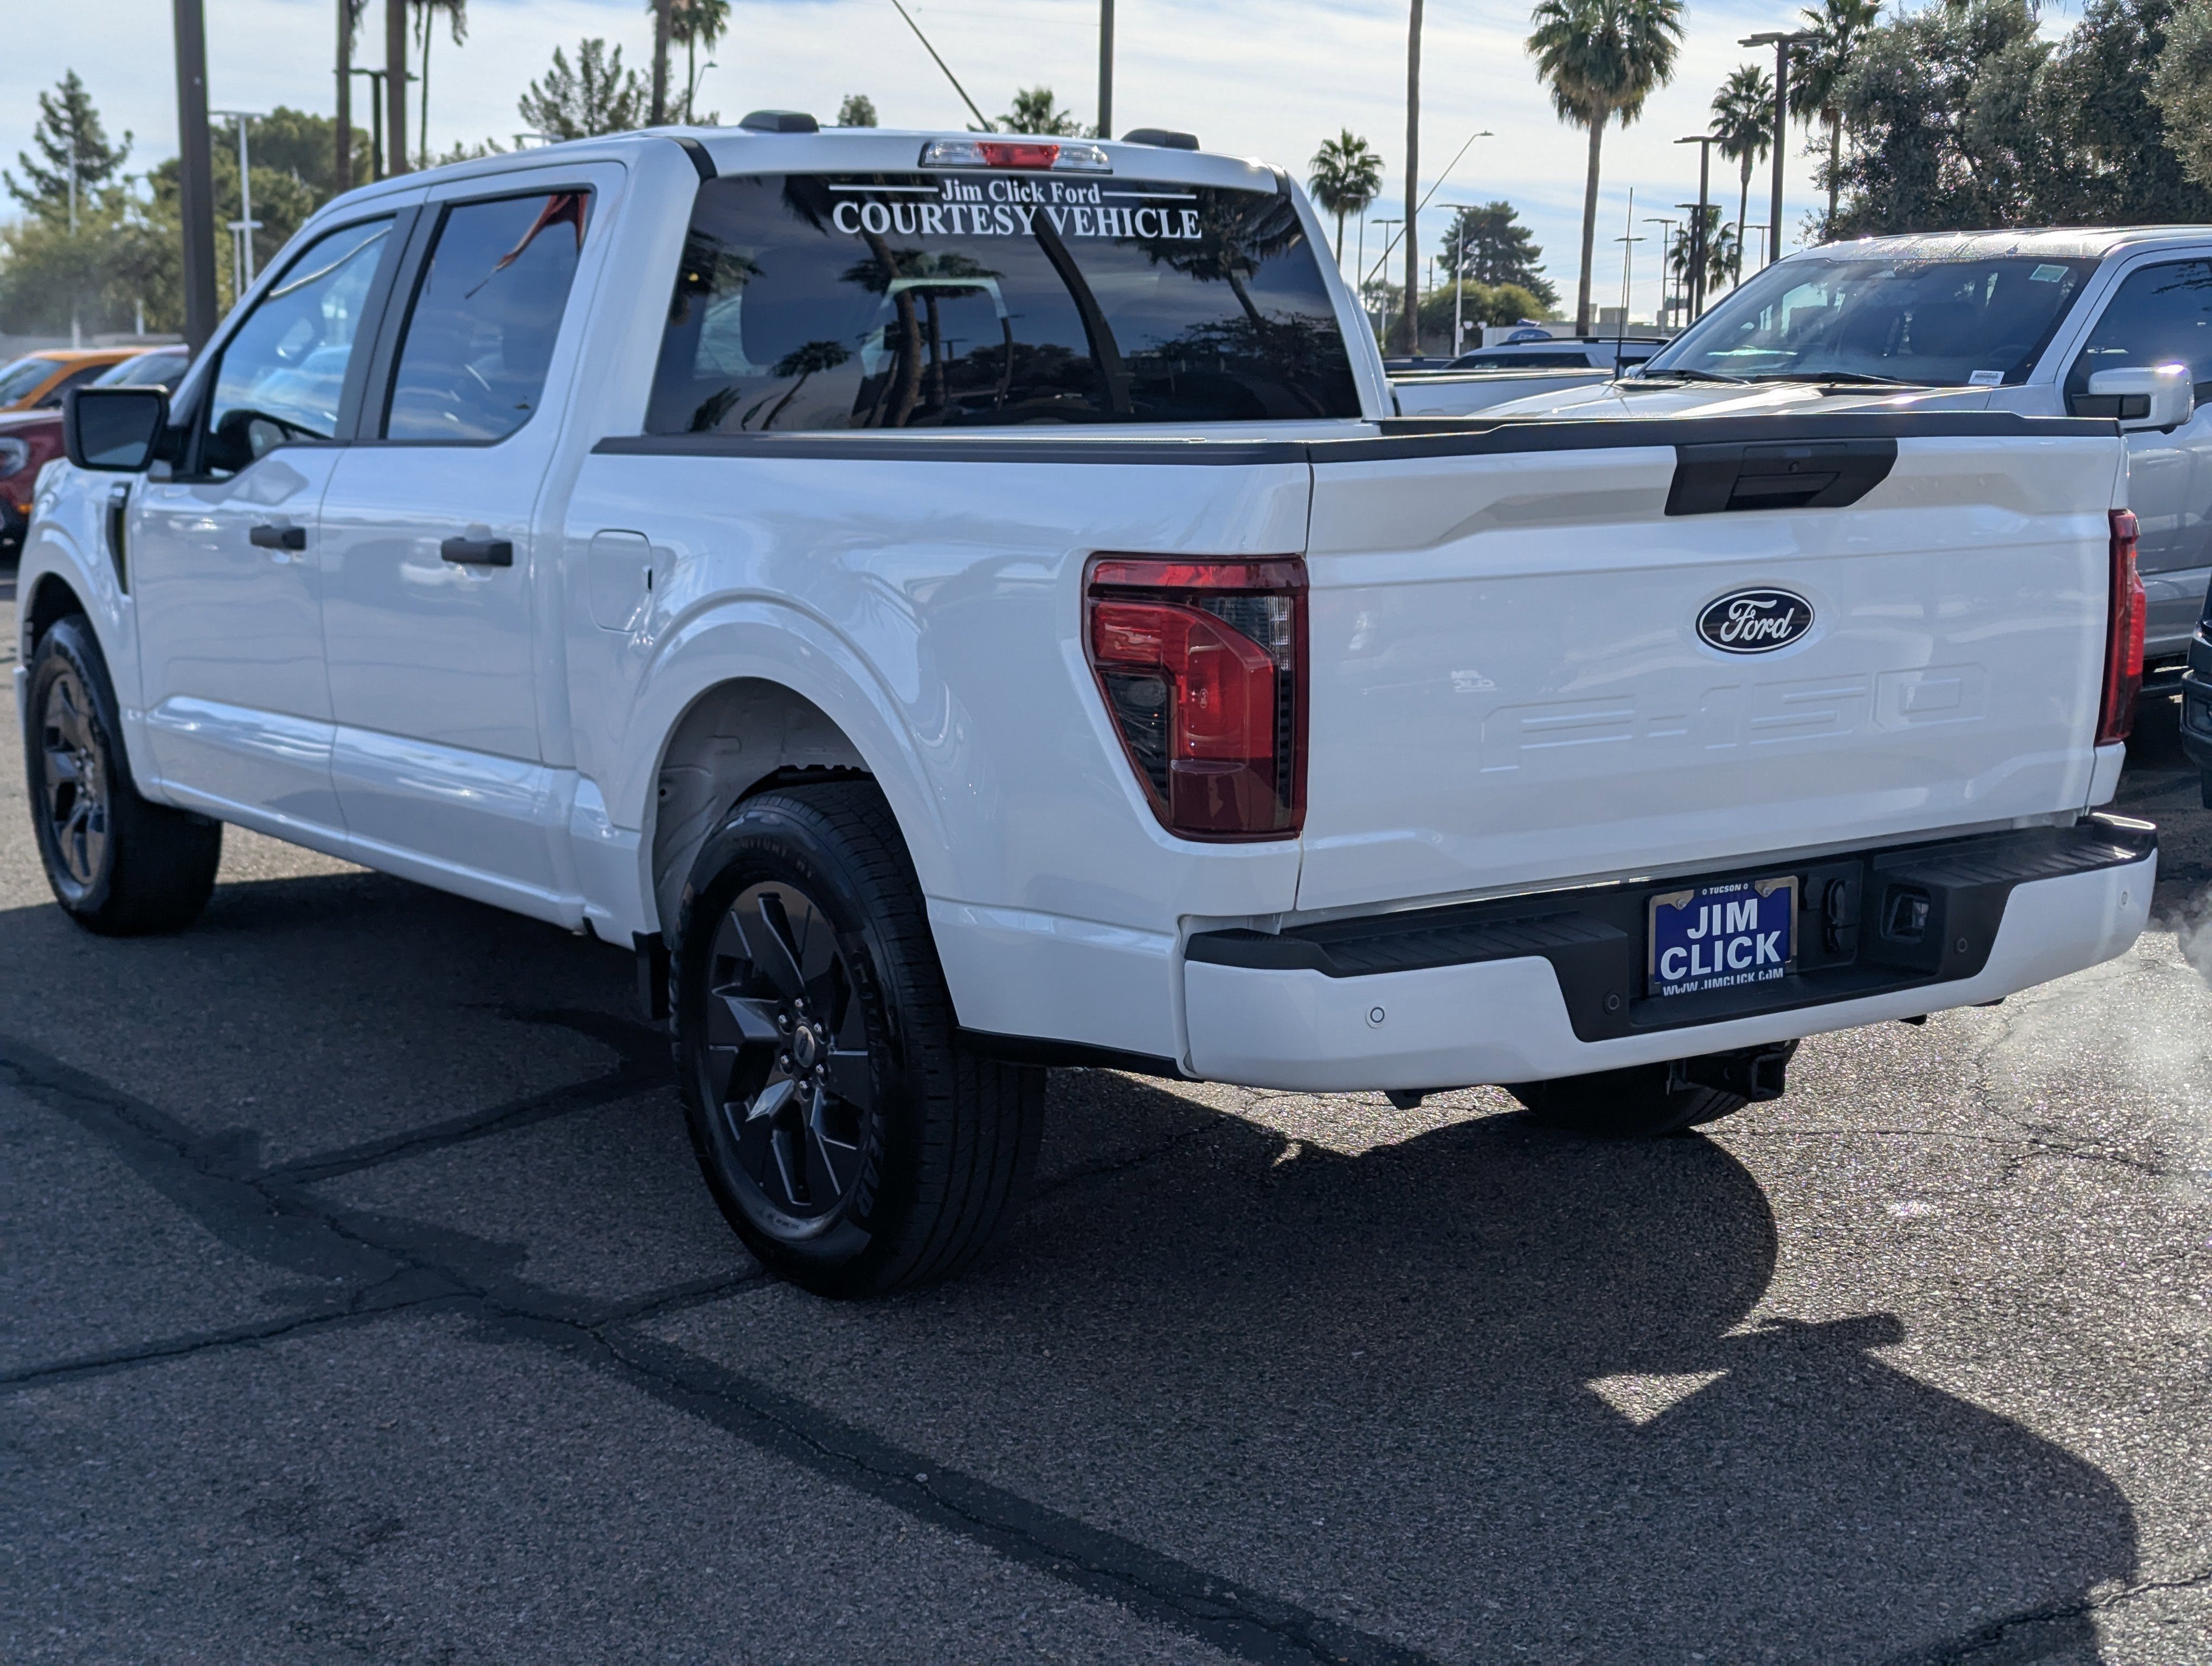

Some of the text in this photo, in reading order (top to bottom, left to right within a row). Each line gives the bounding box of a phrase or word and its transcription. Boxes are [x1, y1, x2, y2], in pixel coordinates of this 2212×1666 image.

[941, 180, 1102, 204] Jim Click Ford
[832, 201, 1203, 239] COURTESY VEHICLE
[1720, 599, 1795, 642] Ford
[1709, 883, 1742, 895] TUCSON
[1687, 898, 1758, 939] JIM
[1660, 931, 1782, 981] CLICK
